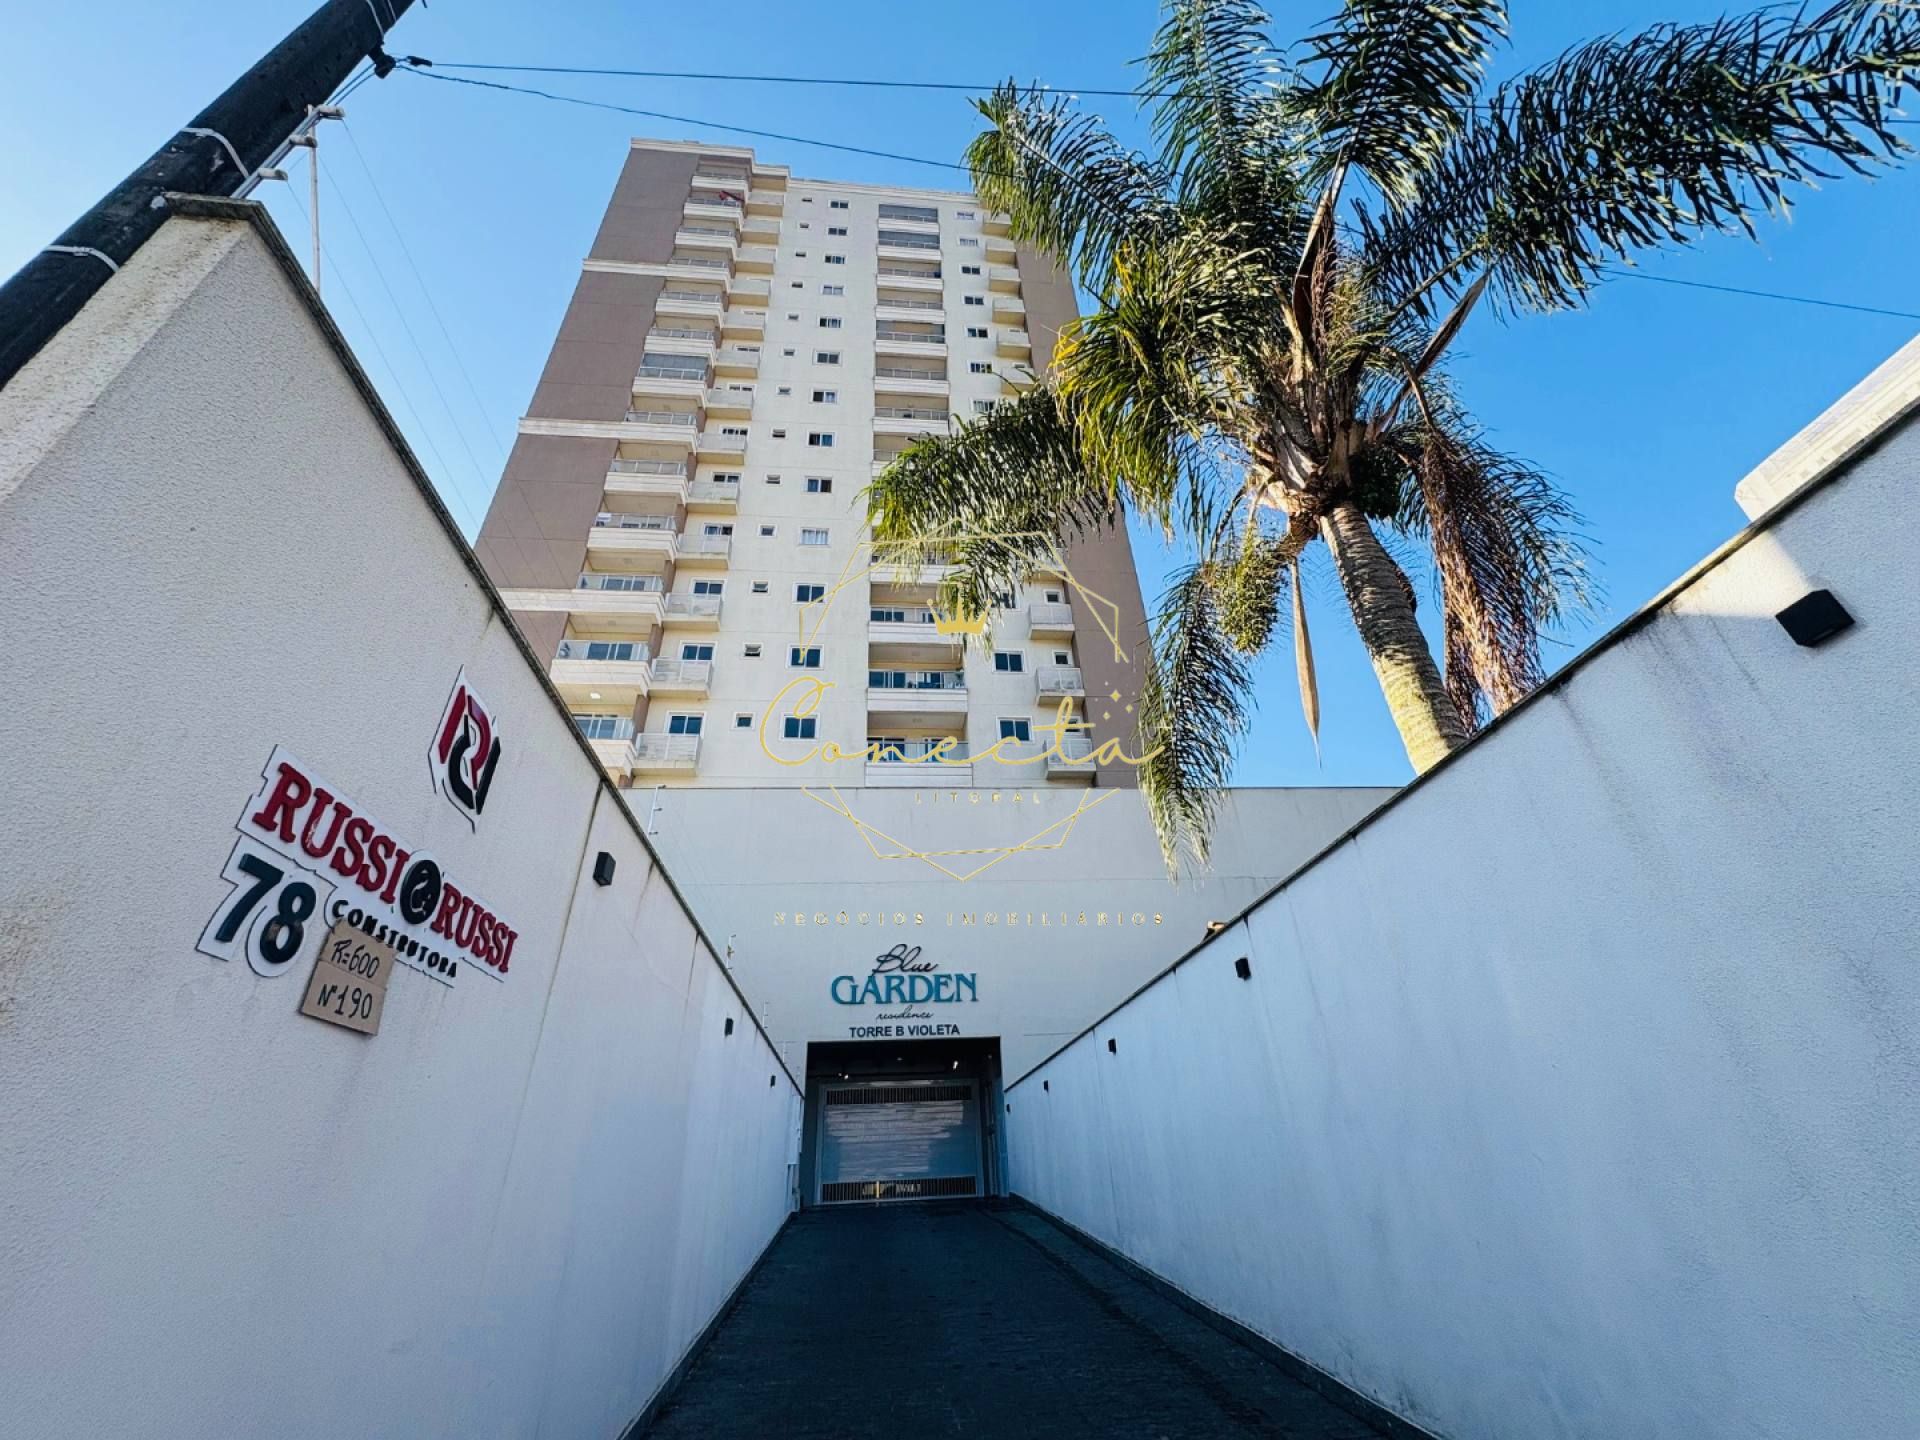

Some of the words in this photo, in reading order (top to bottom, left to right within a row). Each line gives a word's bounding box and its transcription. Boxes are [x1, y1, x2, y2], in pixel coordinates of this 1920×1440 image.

[252, 762, 409, 904] RUSSI
[431, 883, 518, 973] RUSSI
[215, 853, 316, 964] 78
[332, 899, 457, 978] CONSTRUTORA
[872, 944, 939, 975] Blue
[831, 973, 979, 1005] GARDEN
[876, 1005, 934, 1021] residence
[849, 1026, 892, 1038] TORRE
[895, 1026, 904, 1037] B
[907, 1024, 960, 1036] VIOLETA
